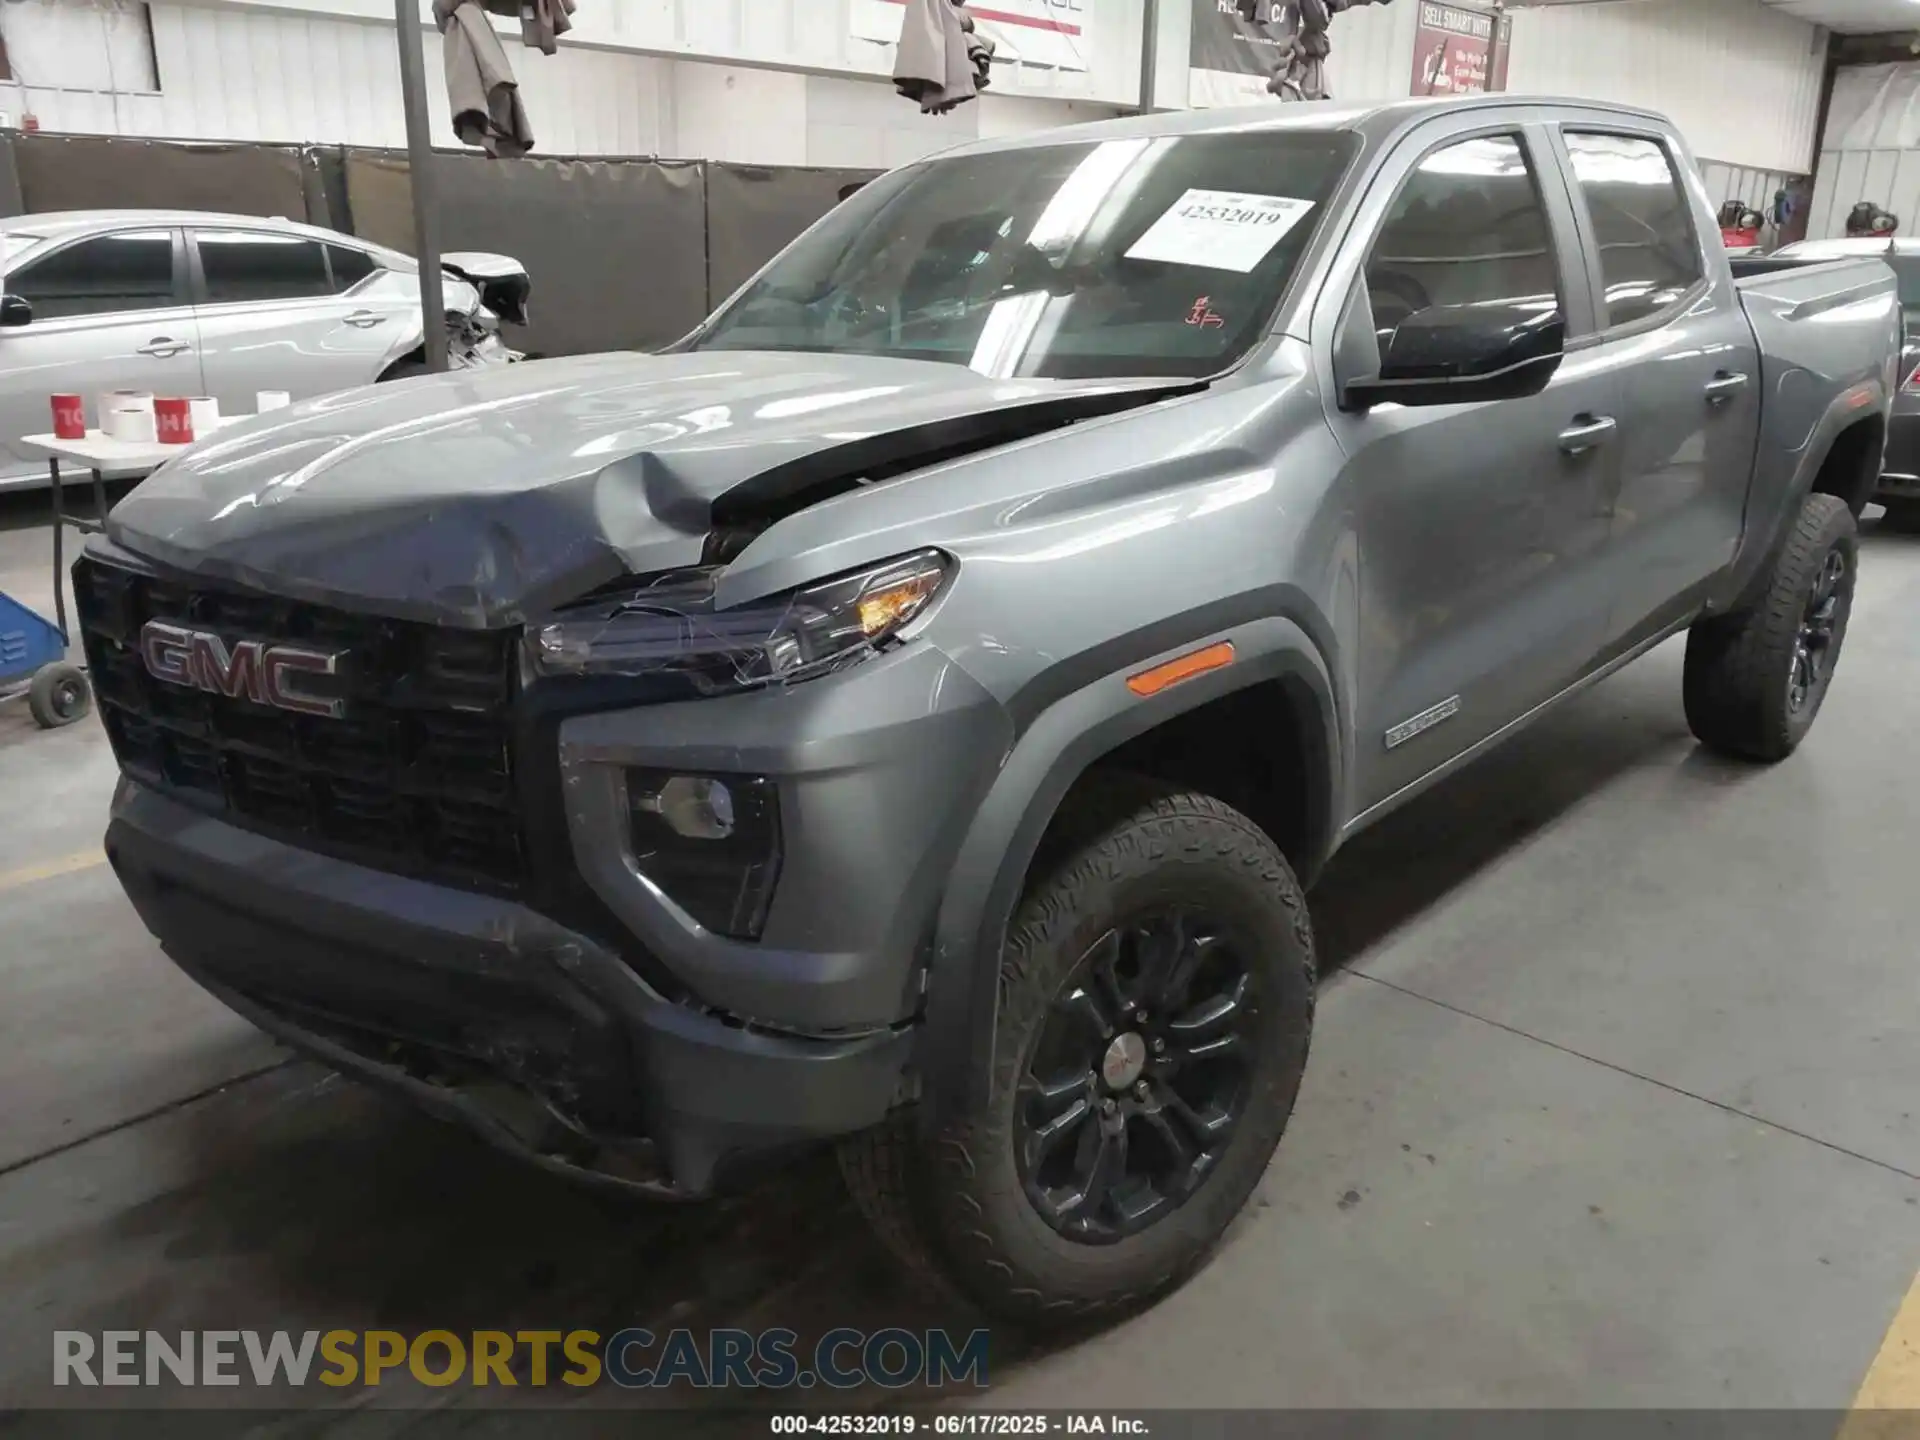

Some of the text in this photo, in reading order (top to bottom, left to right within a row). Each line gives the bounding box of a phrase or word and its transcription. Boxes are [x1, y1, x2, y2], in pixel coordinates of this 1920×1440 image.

[1424, 6, 1442, 26] SELL
[1178, 204, 1281, 225] 42532019
[140, 620, 345, 719] GMC
